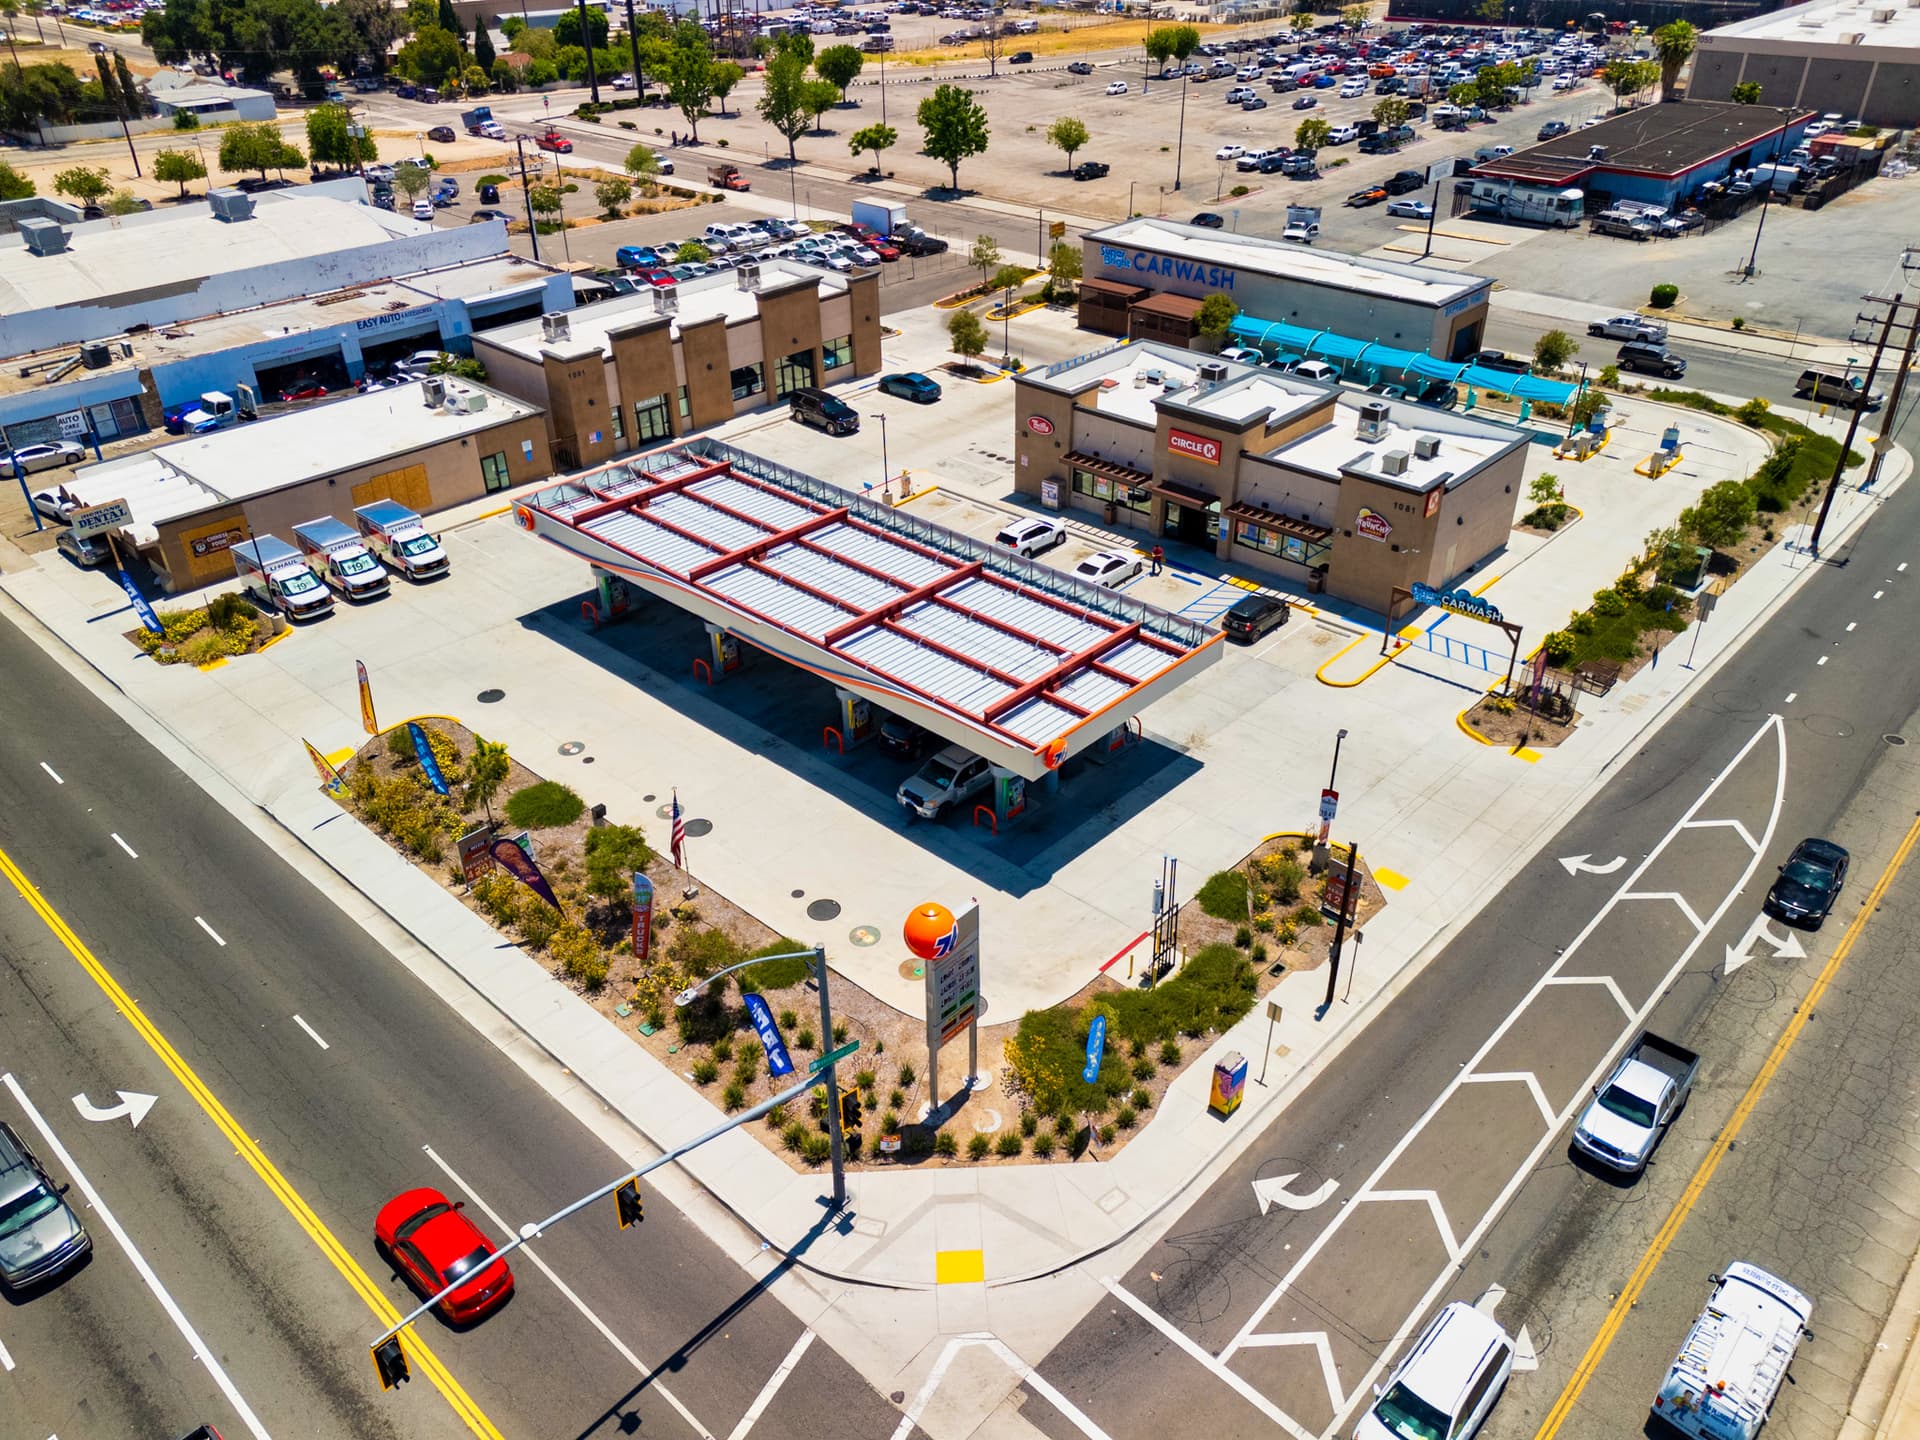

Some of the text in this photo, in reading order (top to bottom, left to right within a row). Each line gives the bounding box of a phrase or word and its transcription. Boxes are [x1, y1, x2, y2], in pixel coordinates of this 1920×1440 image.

[1133, 253, 1235, 290] CARWASH
[356, 317, 378, 331] EASY
[378, 313, 402, 327] AUTO
[57, 414, 80, 426] AUTO
[1170, 436, 1216, 458] CIRCLE K
[1394, 501, 1416, 514] 1081
[78, 510, 128, 530] DENTAL
[1441, 596, 1503, 622] CARWASH
